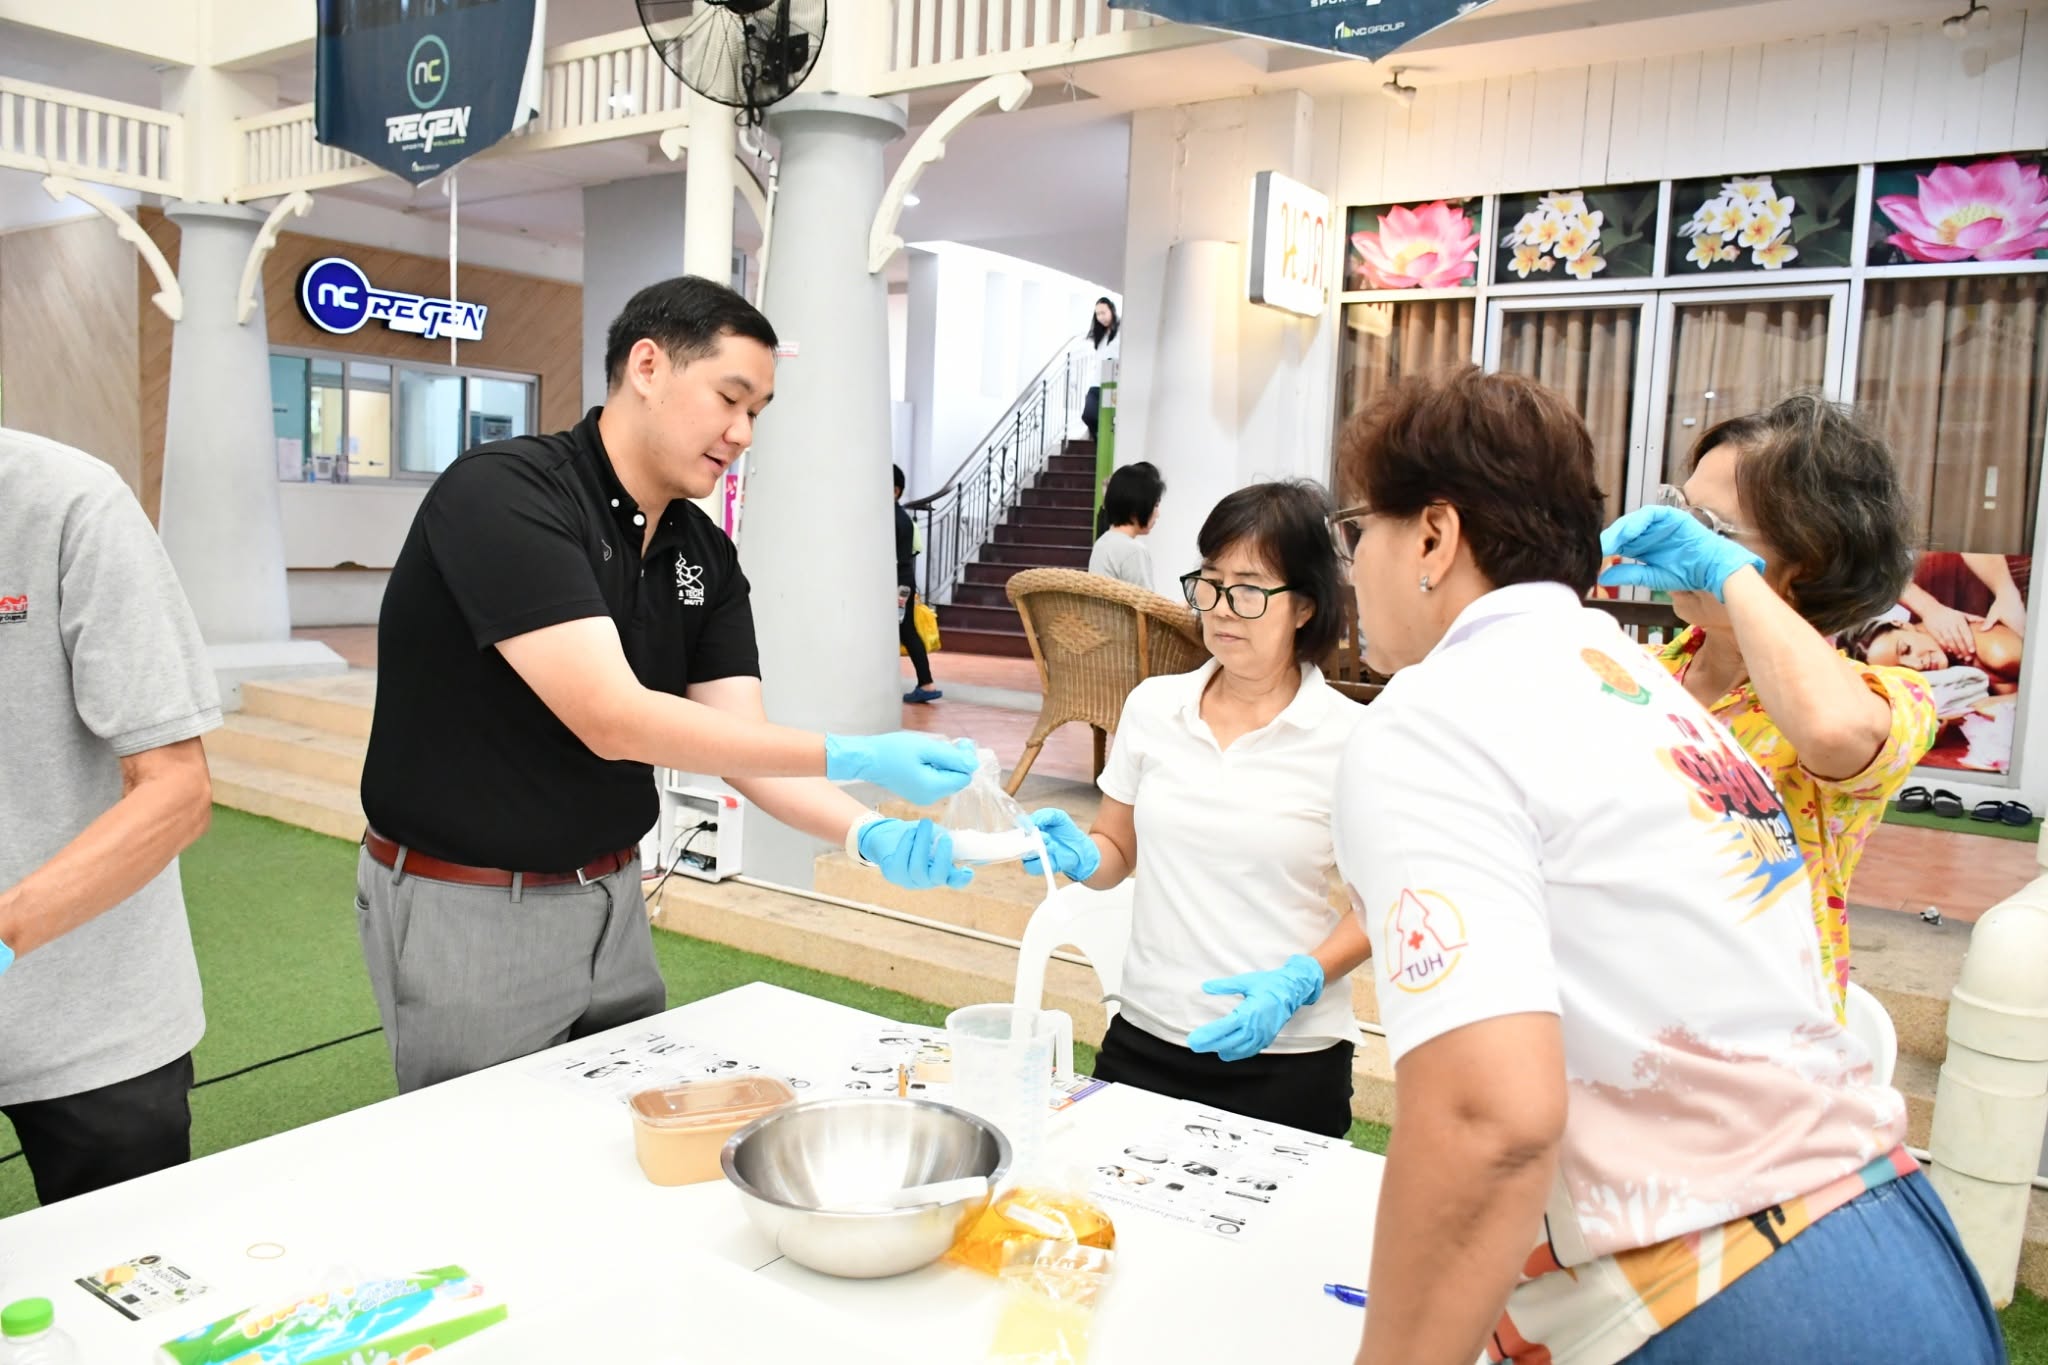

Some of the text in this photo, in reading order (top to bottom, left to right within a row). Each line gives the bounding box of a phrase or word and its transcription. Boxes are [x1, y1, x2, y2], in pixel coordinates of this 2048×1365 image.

[1368, 21, 1406, 34] GROUP
[385, 106, 471, 153] REGEN
[367, 293, 485, 337] REGEN
[1406, 952, 1444, 982] TUH
